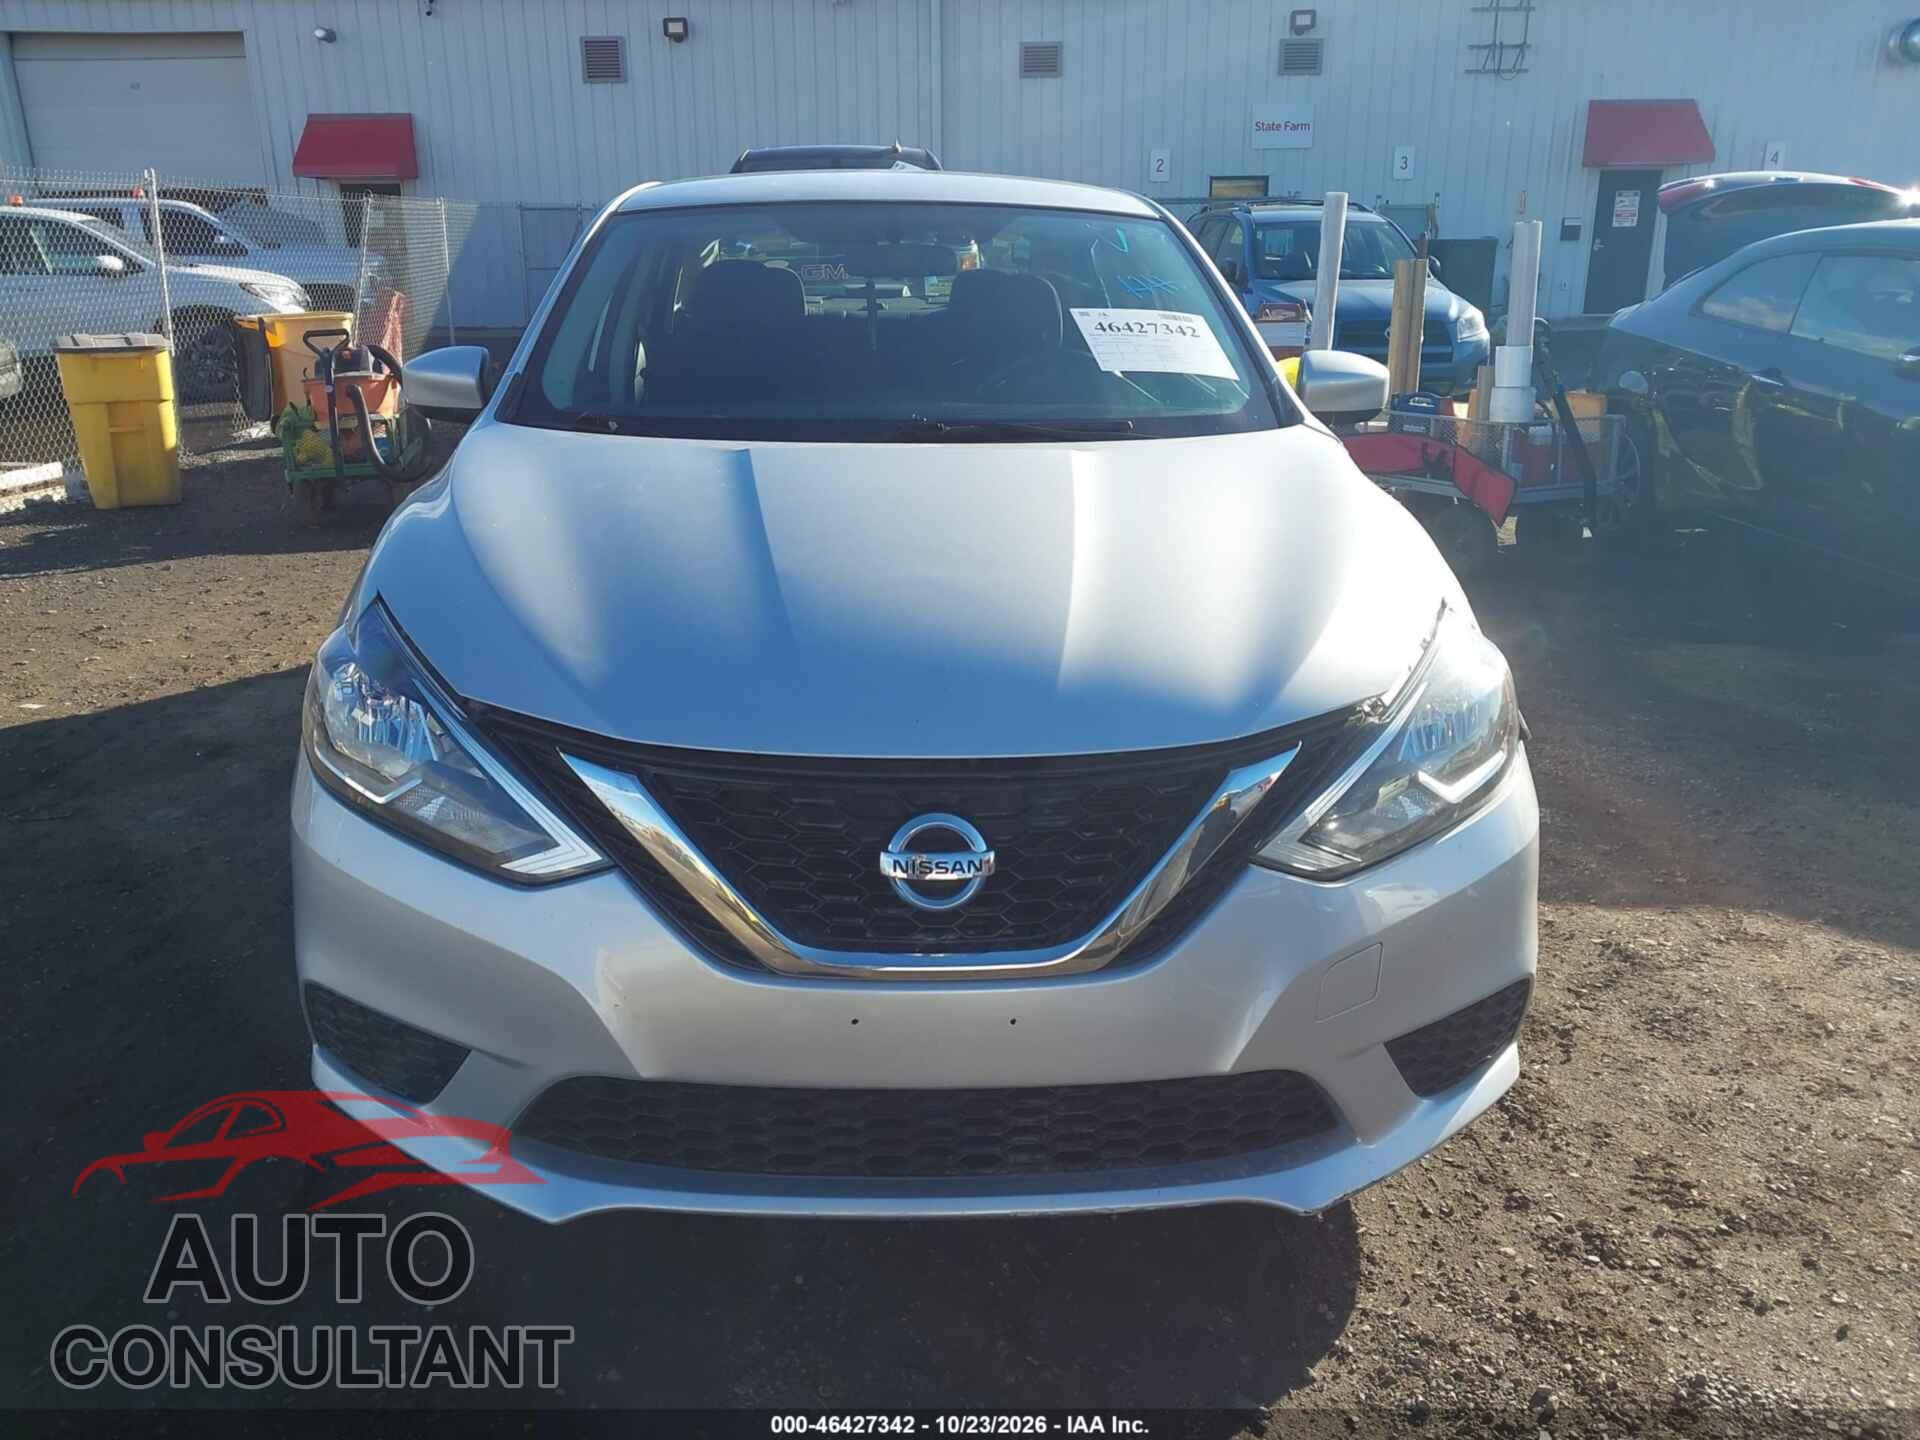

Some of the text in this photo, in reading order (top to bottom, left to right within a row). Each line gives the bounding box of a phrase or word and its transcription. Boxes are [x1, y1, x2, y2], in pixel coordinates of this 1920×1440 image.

[1255, 120, 1311, 132] State Farm
[1156, 158, 1164, 173] 2
[1399, 156, 1408, 170] 3
[1770, 150, 1778, 167] 4
[801, 263, 849, 280] GM
[1093, 320, 1201, 338] 46427342
[892, 859, 983, 875] NISSAN
